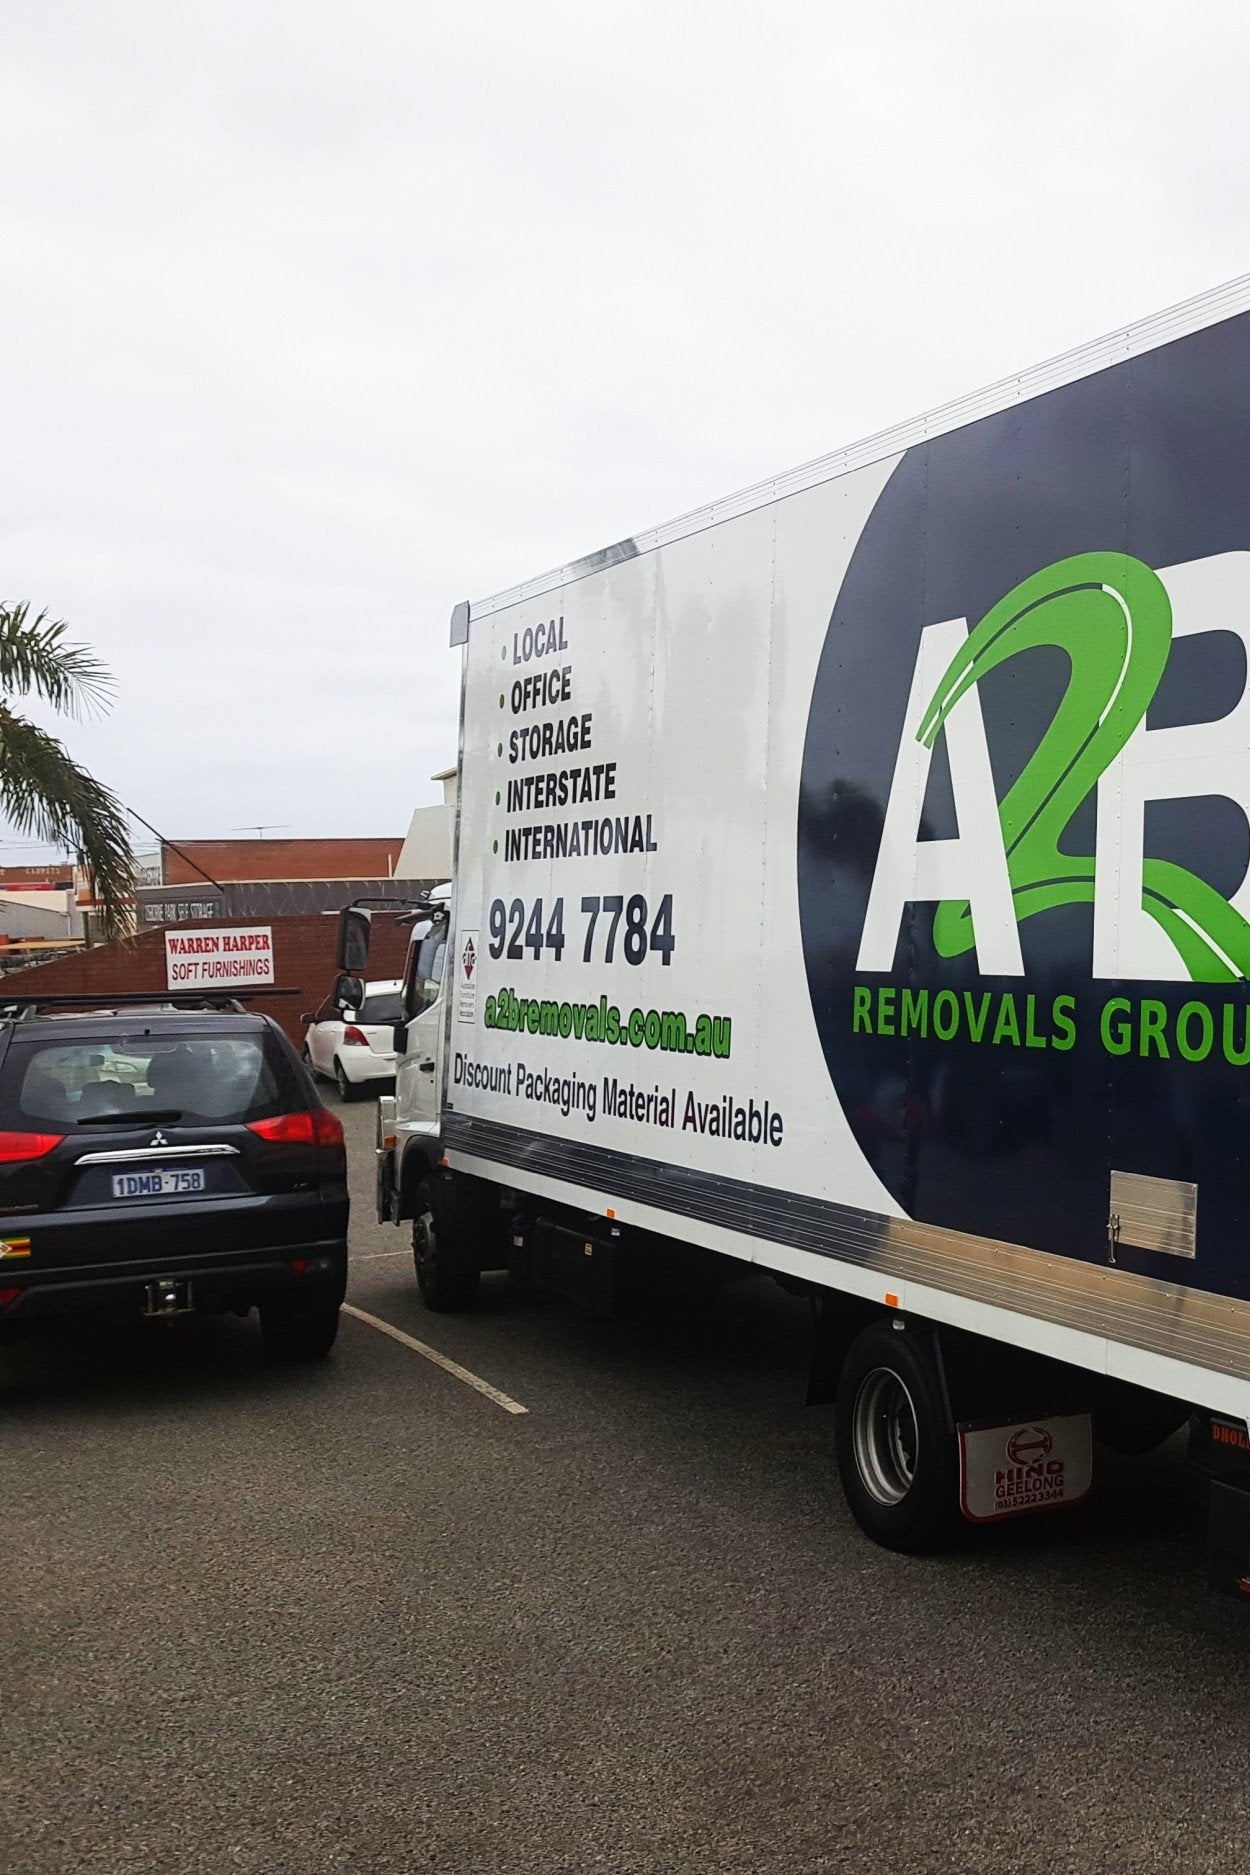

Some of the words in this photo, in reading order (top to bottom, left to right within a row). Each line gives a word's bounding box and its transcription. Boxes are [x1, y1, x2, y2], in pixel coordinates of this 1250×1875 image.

[512, 616, 568, 666] LOCAL
[511, 666, 572, 714] OFFICE
[509, 713, 592, 763] STORAGE
[506, 763, 617, 813] INTERSTATE
[504, 814, 657, 862] INTERNATIONAL
[168, 936, 219, 954] WARREN
[222, 934, 270, 952] HARPER
[488, 897, 565, 962] 9244
[581, 894, 675, 967] 7784
[172, 962, 199, 980] SOFT
[202, 958, 269, 979] FURNISHINGS
[484, 988, 731, 1059] a2bremovals.com.au
[852, 985, 1077, 1051] REMOVALS
[454, 1052, 512, 1096] Discount
[516, 1063, 597, 1123] Packaging
[602, 1077, 676, 1129] Material
[681, 1091, 784, 1147] Available
[995, 1460, 1065, 1484] HINO
[995, 1474, 1064, 1499] GEELONG
